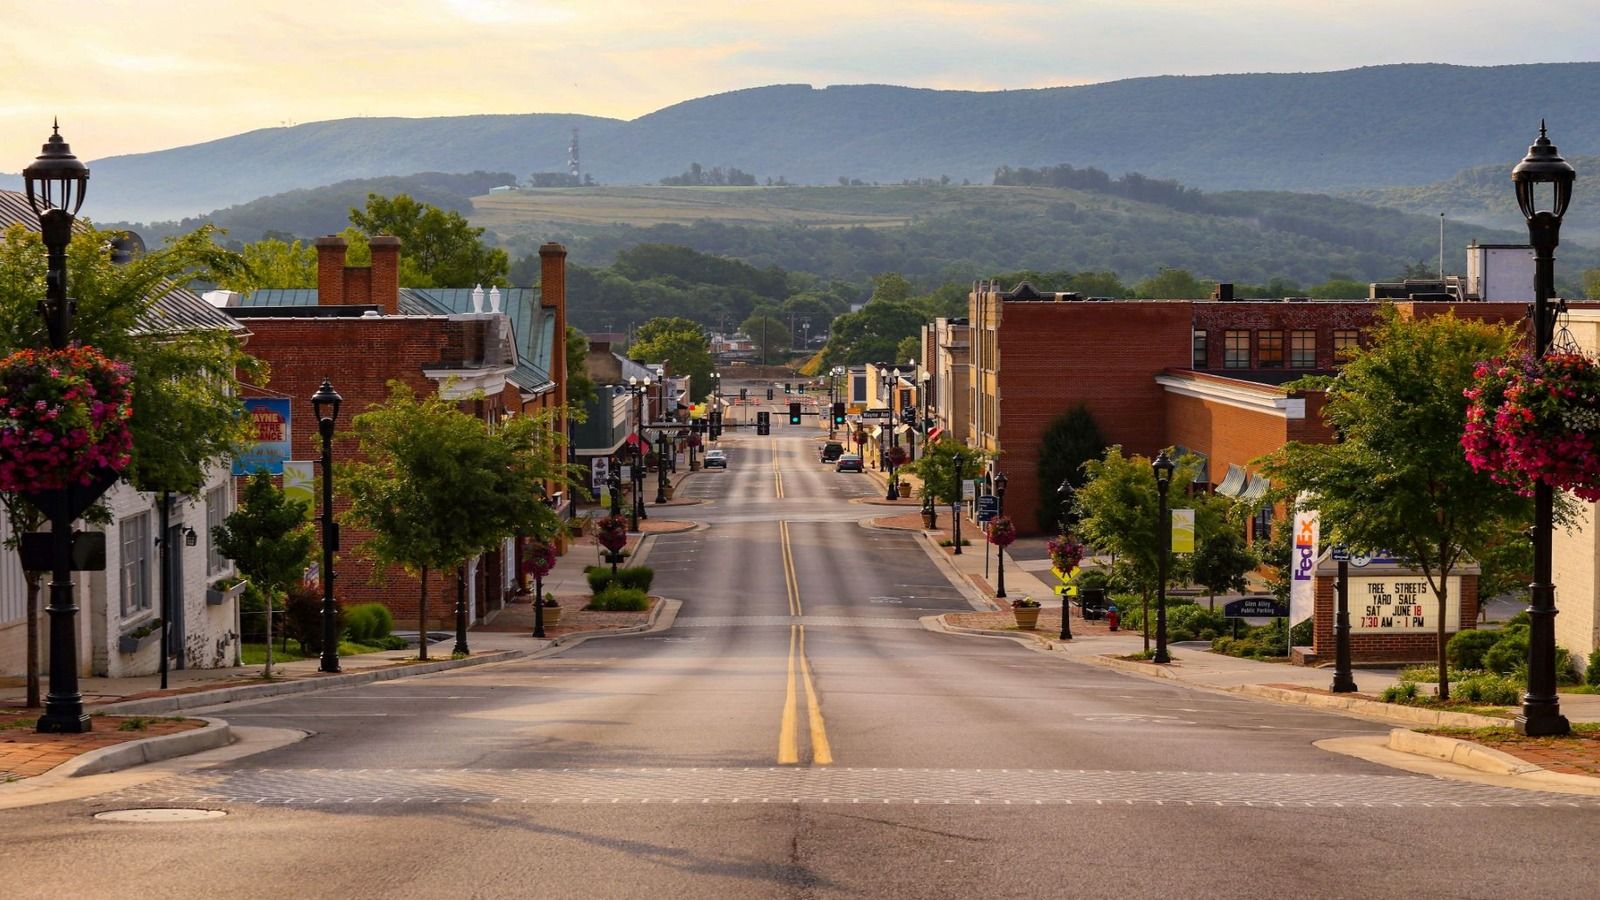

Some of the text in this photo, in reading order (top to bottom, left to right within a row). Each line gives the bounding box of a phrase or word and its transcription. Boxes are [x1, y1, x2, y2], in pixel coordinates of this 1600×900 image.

[1294, 520, 1313, 580] FedEx
[1368, 583, 1385, 594] TREE
[1373, 594, 1417, 605] YARD SALE
[1366, 605, 1422, 616] SAT JUNE 18
[1361, 616, 1379, 628] 7:30
[1381, 616, 1393, 628] AM
[1405, 616, 1408, 628] 1
[1412, 616, 1424, 628] PM
